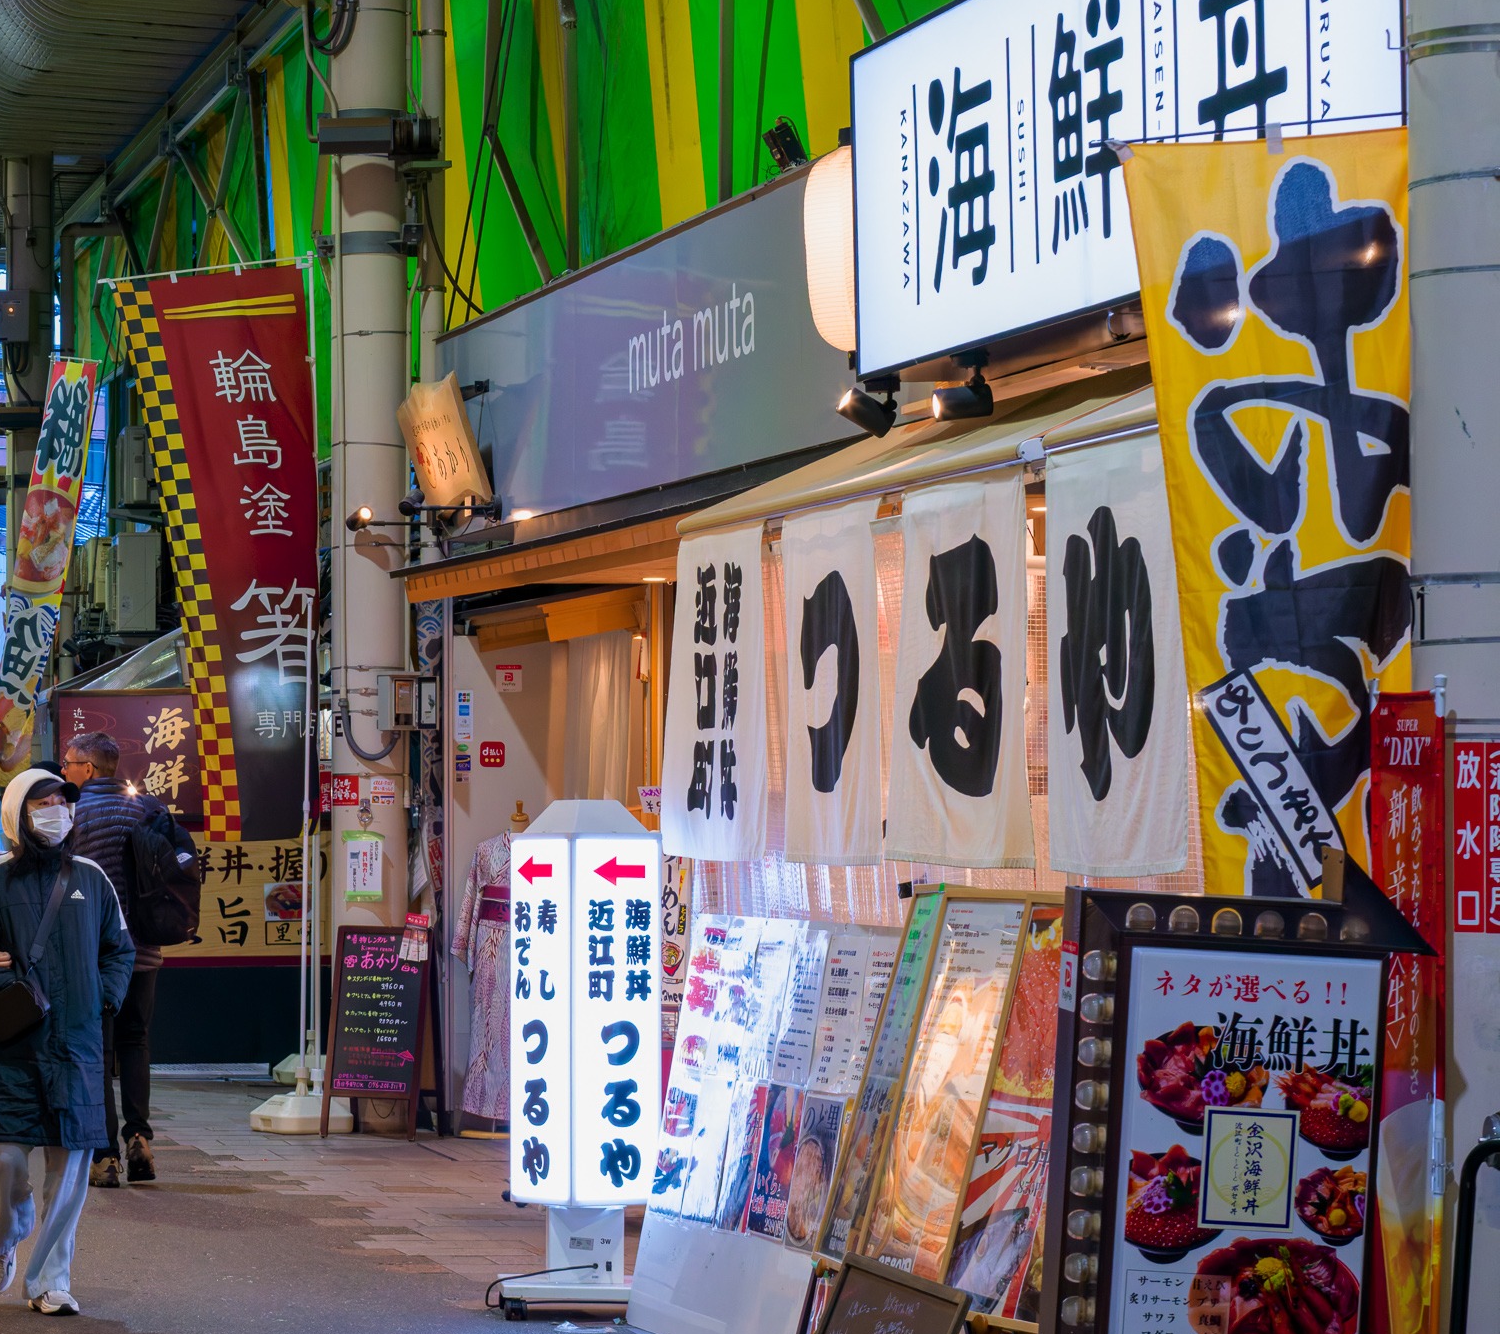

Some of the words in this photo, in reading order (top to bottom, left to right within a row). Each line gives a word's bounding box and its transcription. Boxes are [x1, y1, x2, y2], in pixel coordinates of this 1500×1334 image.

[898, 107, 911, 291] KANAZAWA
[1016, 99, 1026, 205] SUSHI
[628, 310, 685, 395] muta
[692, 282, 756, 373] muta
[209, 348, 294, 538] 輪島塗
[73, 708, 86, 738] 近江
[687, 563, 717, 821] 近江町
[721, 561, 743, 821] 海鮮丼
[1396, 719, 1419, 732] SUPER
[143, 708, 190, 815] 海鮮
[1457, 750, 1481, 925] 放水口
[351, 934, 388, 944] 着物レンタル
[360, 951, 399, 971] あかり
[514, 900, 531, 1002] おでん
[588, 900, 615, 1002] 近江町
[625, 900, 652, 1002] 海鮮丼
[1212, 1011, 1371, 1078] 海鮮丼
[521, 1020, 551, 1185] つるや
[599, 1020, 642, 1188] つるや
[1242, 1122, 1265, 1216] 金沢海鮮丼
[1129, 1292, 1190, 1306] 炙りサーモン
[1138, 1275, 1185, 1287] サーモン
[1142, 1312, 1176, 1323] サワラ
